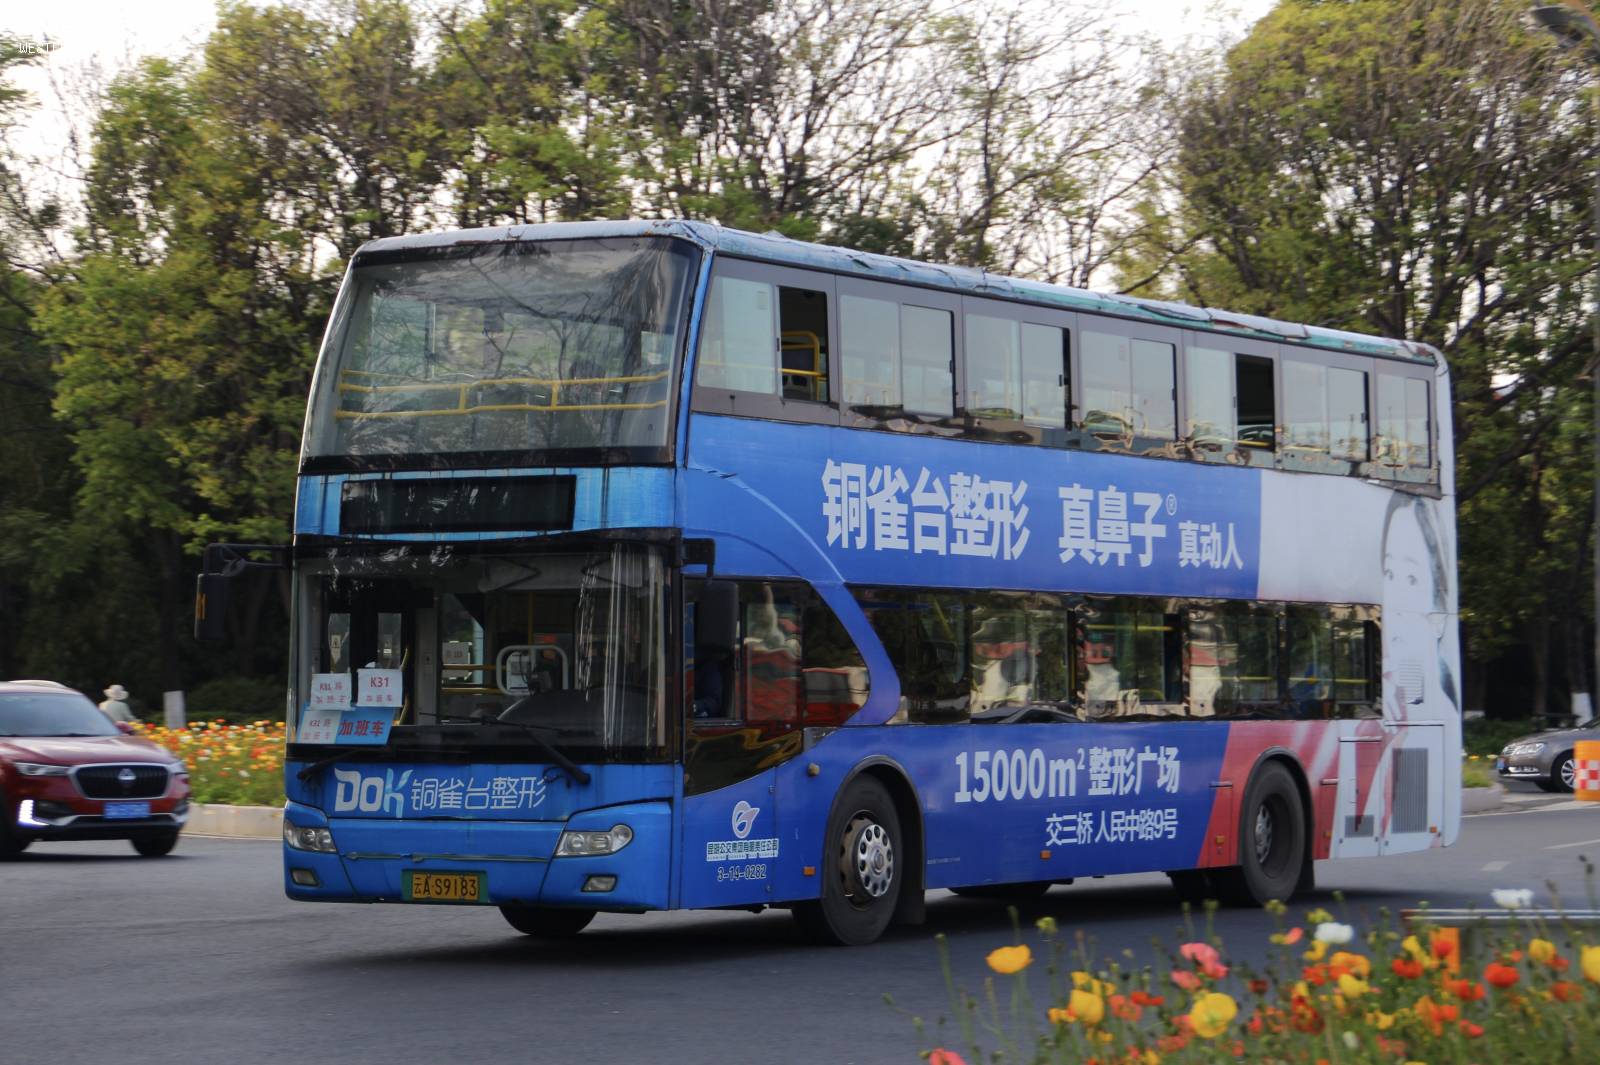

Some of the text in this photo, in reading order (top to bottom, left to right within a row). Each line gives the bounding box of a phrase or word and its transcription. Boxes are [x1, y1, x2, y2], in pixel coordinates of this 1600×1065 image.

[821, 458, 1031, 561] 铜雀台整形
[1178, 520, 1244, 570] 真动人
[370, 677, 389, 688] K31
[338, 720, 385, 736] 加班车
[410, 776, 547, 811] 铜雀台整形
